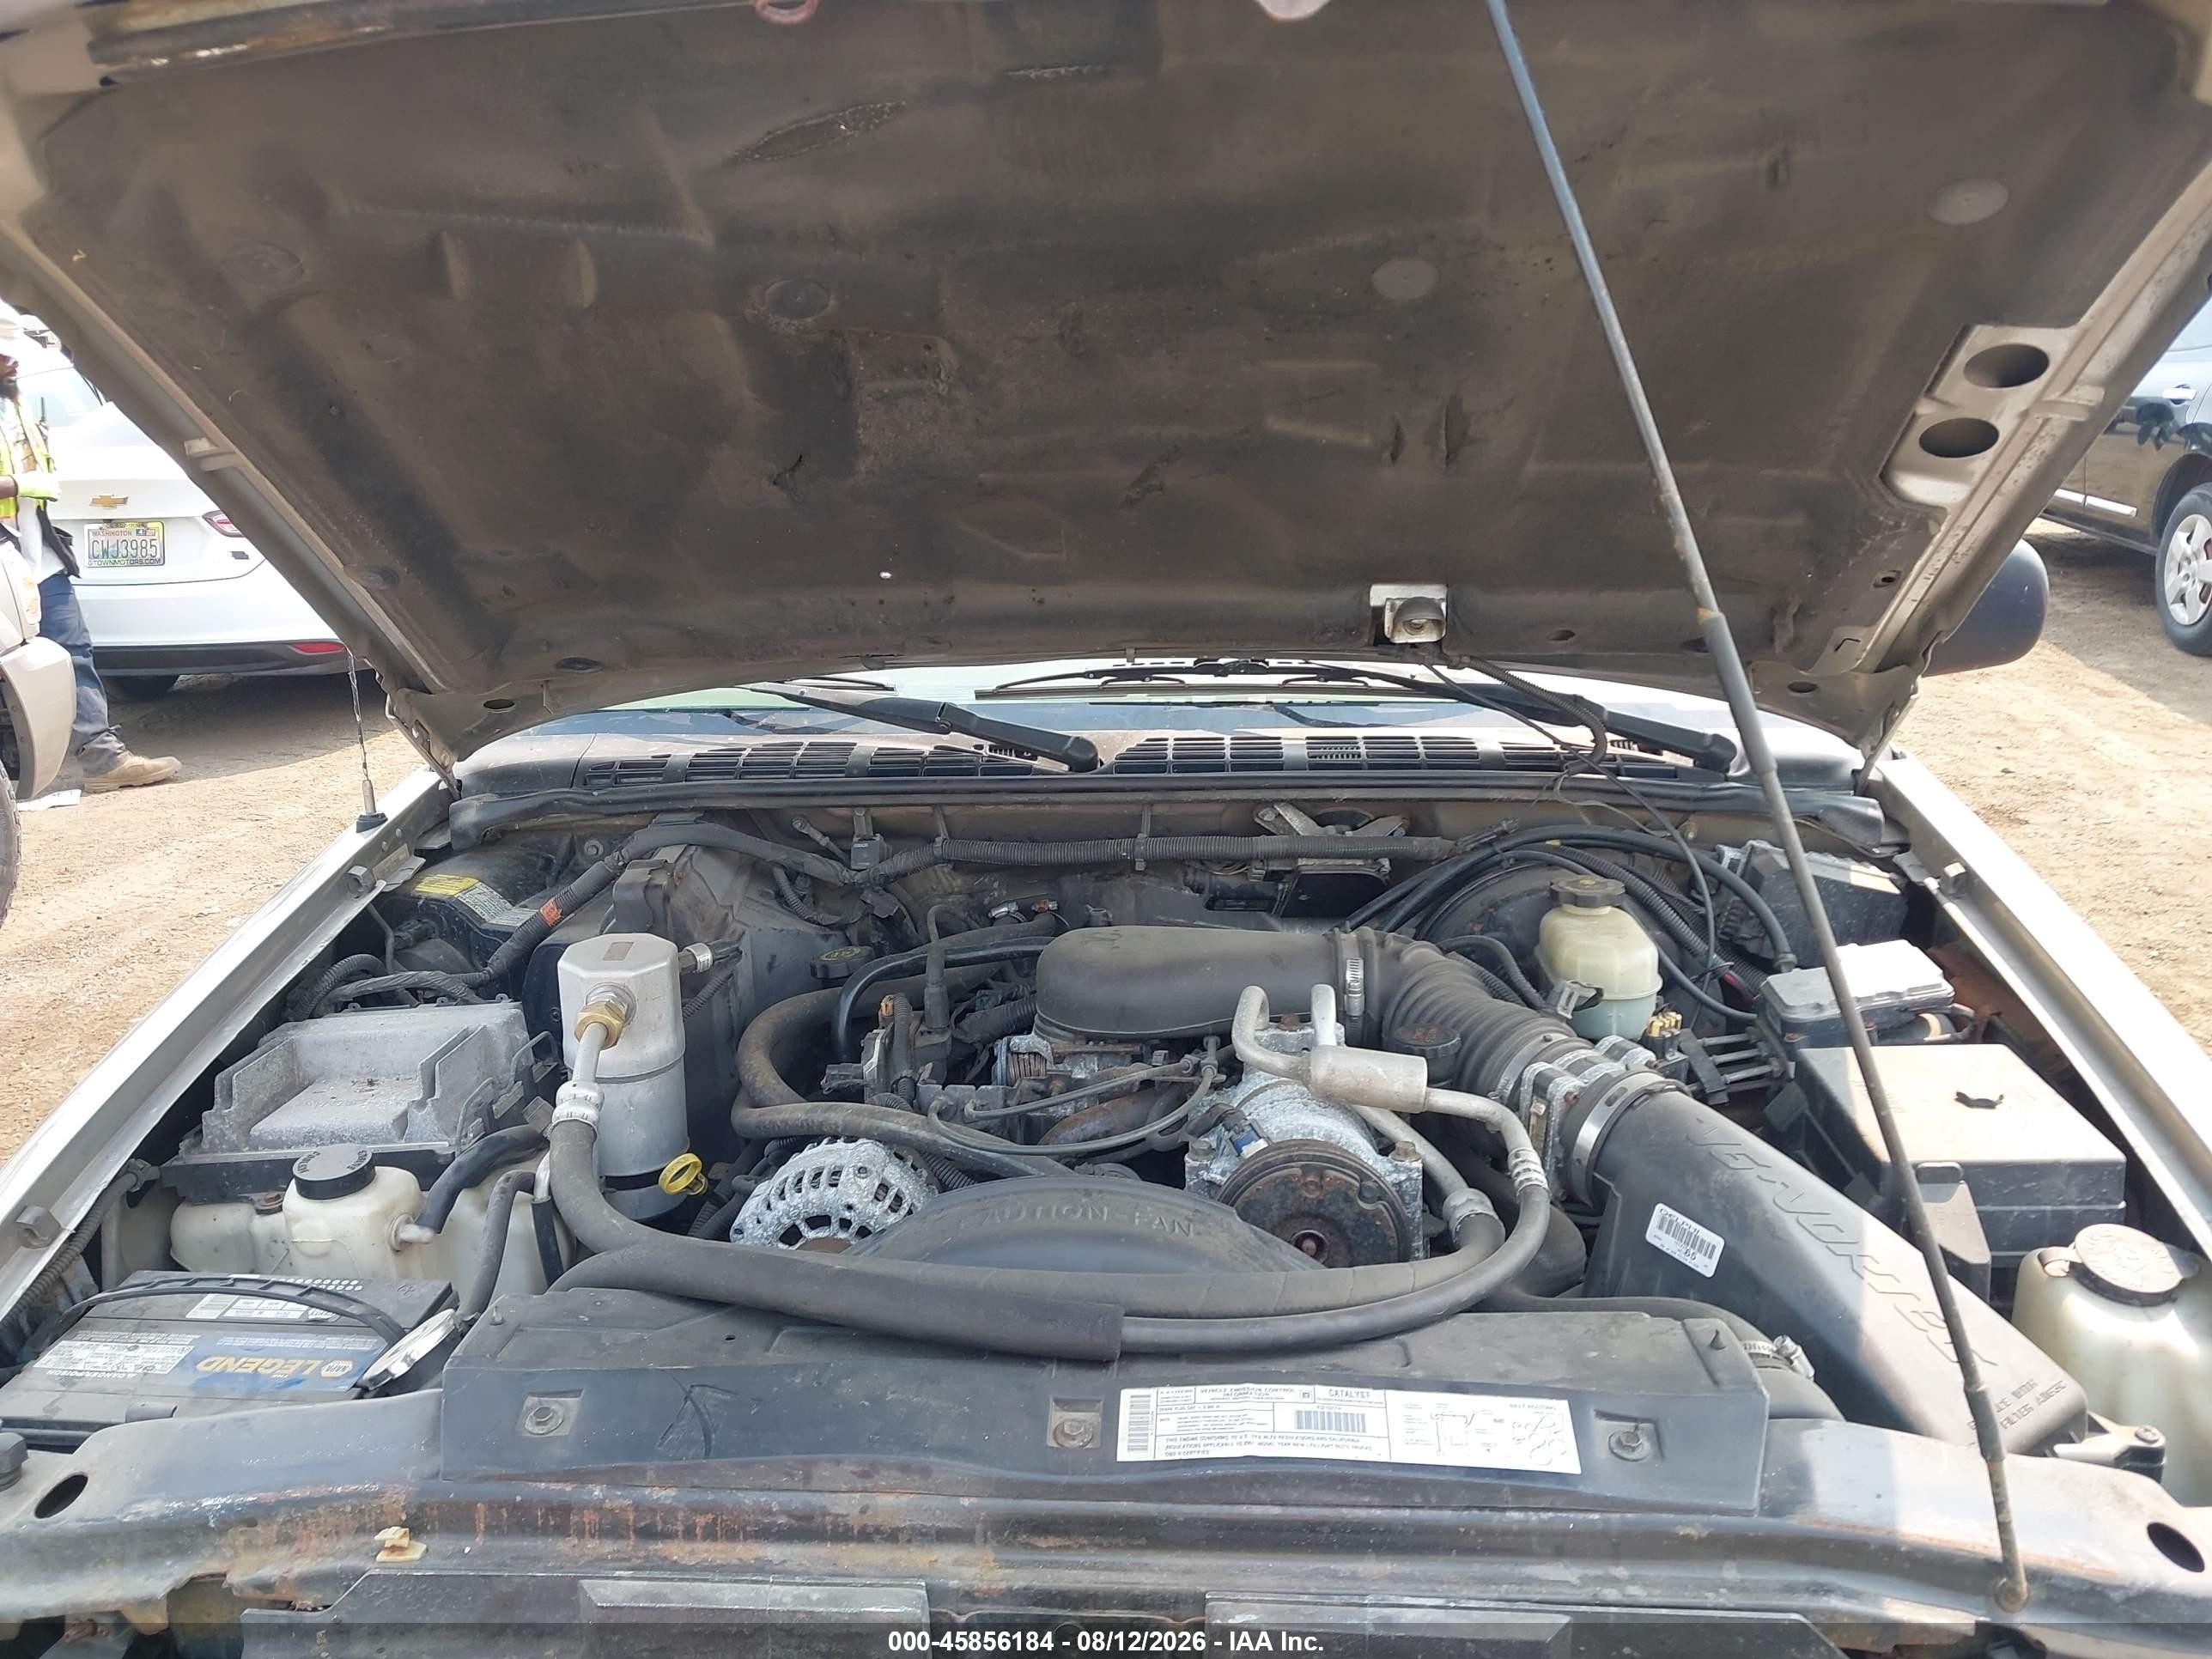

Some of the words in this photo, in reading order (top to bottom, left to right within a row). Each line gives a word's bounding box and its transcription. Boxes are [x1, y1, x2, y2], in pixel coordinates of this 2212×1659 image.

[92, 538, 158, 559] CWJ3985
[88, 558, 161, 567] GTOWNMOTORS.COM
[1133, 1206, 1194, 1238] FAN
[194, 1356, 324, 1376] LEGEND
[1328, 1389, 1370, 1399] CATALYST
